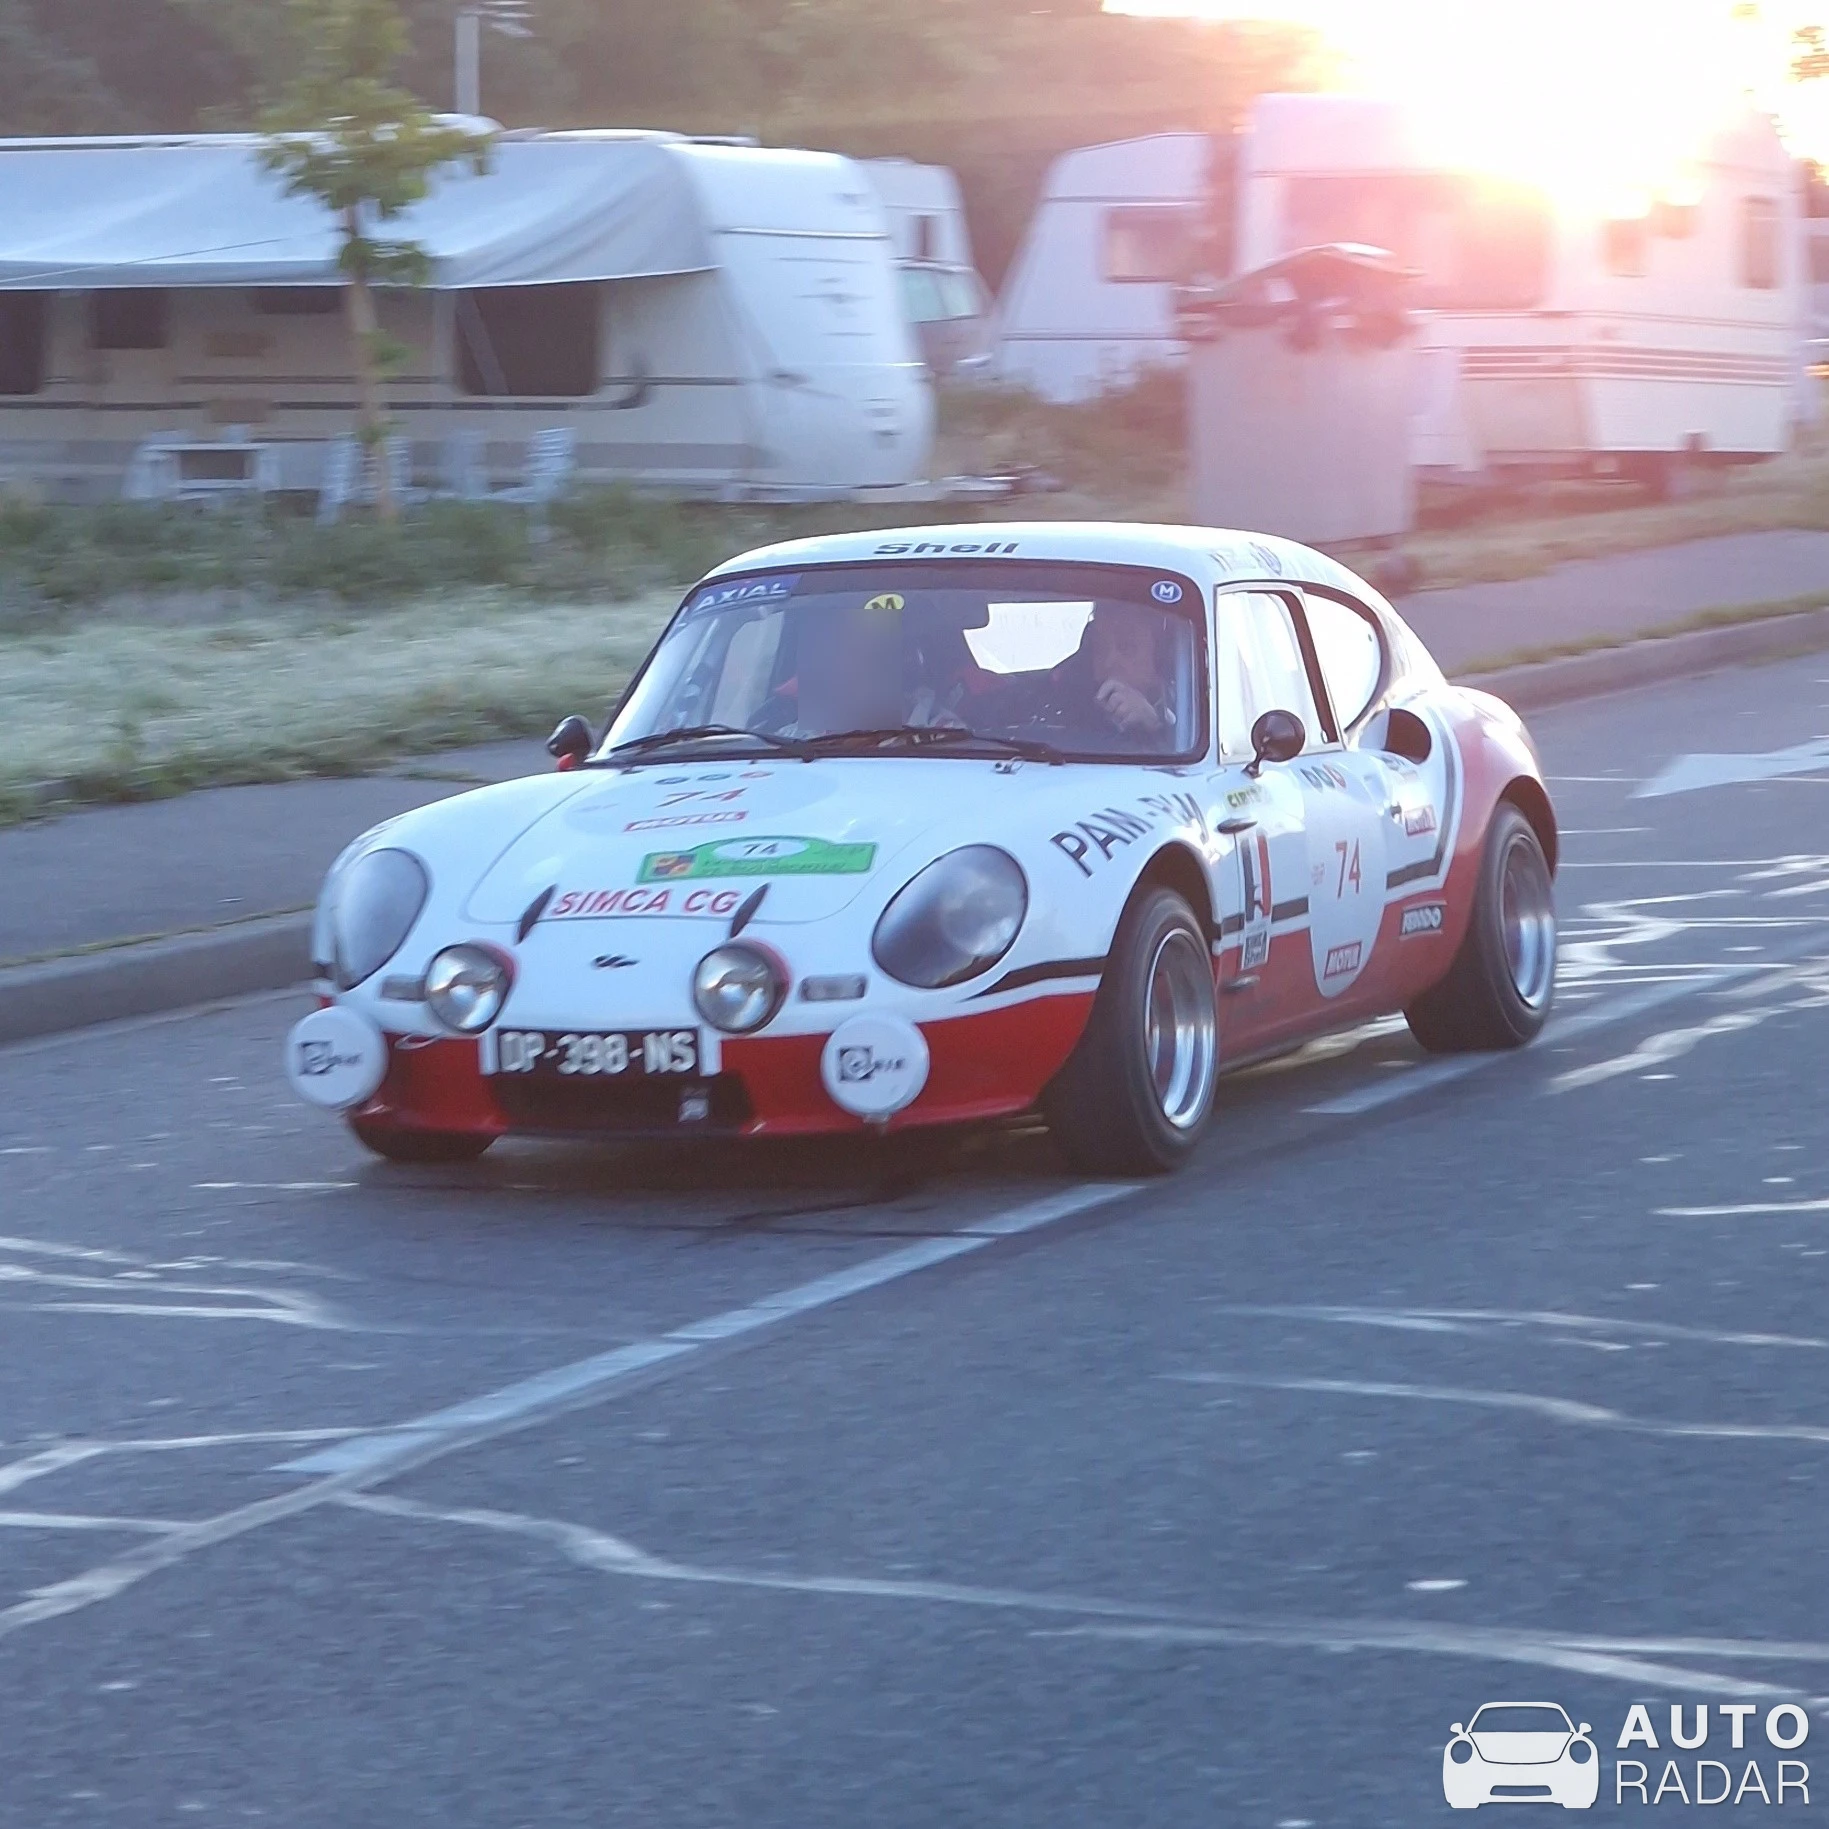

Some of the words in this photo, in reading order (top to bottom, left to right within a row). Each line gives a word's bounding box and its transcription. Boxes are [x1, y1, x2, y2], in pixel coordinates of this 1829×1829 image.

[873, 542, 1020, 555] Shell
[699, 582, 787, 608] AXIAL
[655, 787, 748, 808] 74
[743, 842, 779, 856] 74
[1335, 838, 1361, 899] 74
[553, 889, 673, 915] SIMCA
[683, 889, 740, 914] CG
